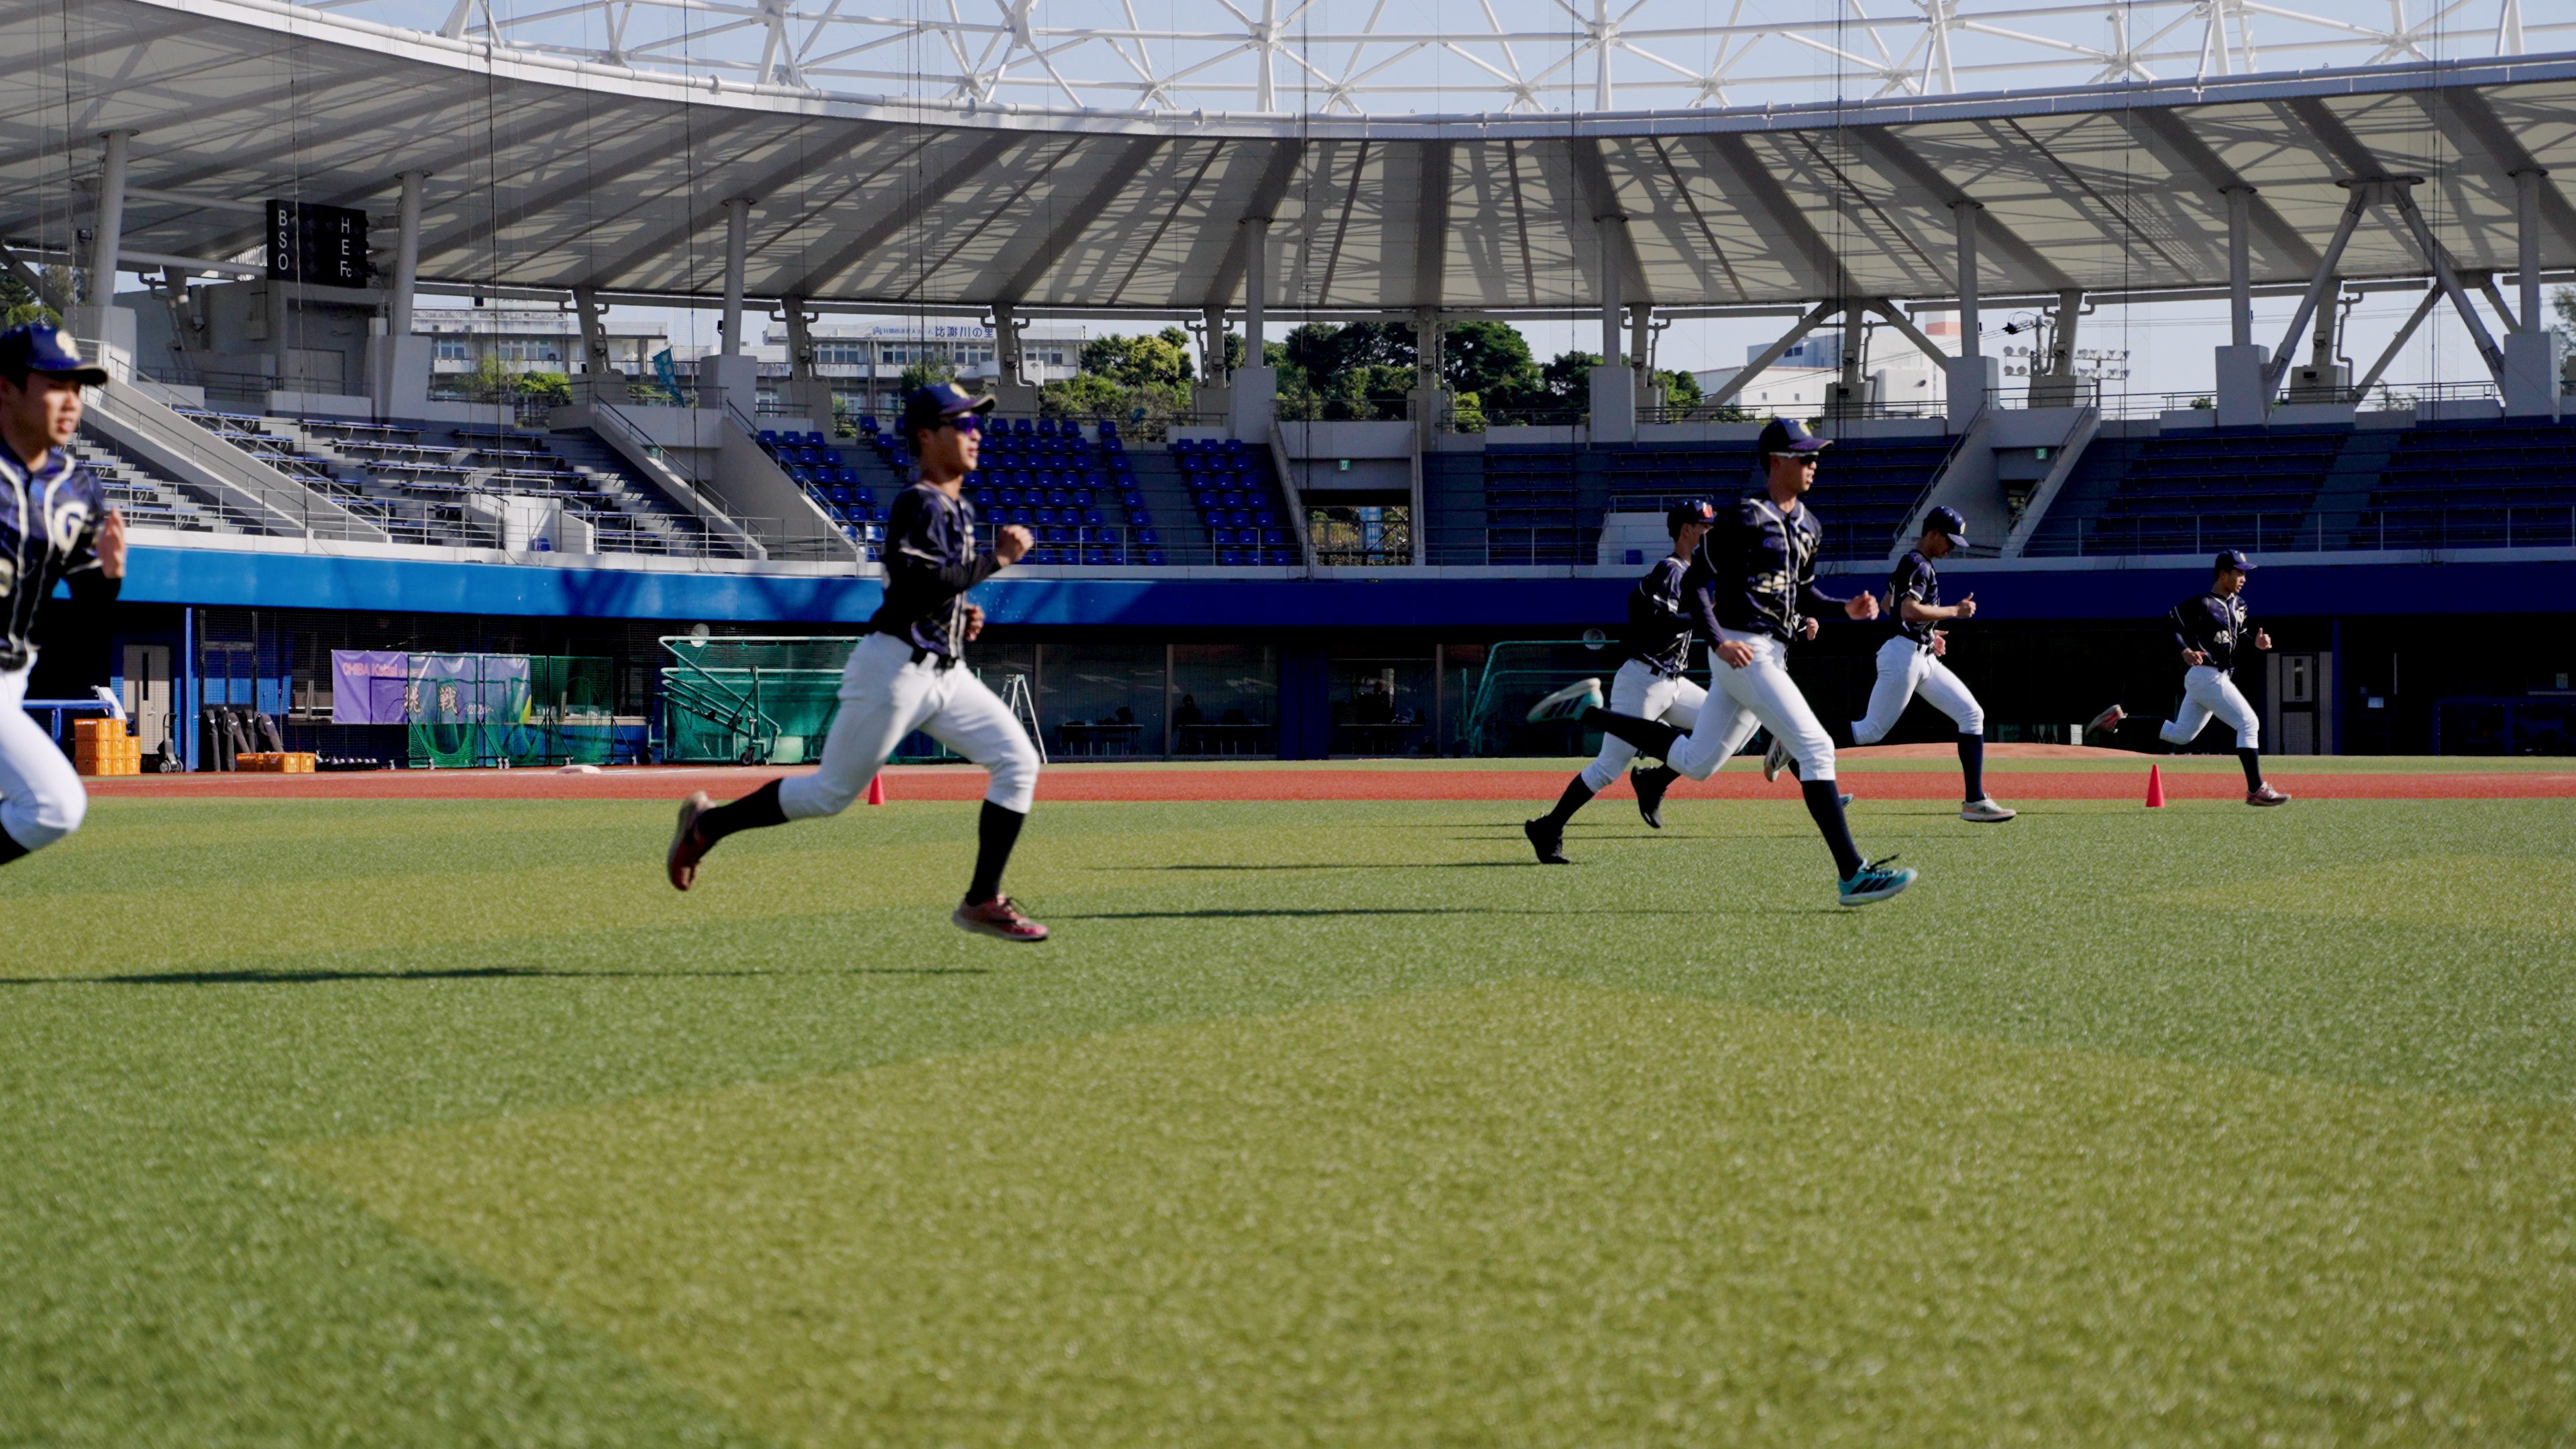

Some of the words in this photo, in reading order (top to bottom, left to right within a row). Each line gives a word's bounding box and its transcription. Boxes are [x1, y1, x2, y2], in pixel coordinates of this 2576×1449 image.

[278, 209, 288, 226] B
[341, 217, 350, 233] H
[278, 231, 288, 248] S
[341, 239, 350, 256] E
[278, 253, 288, 270] O
